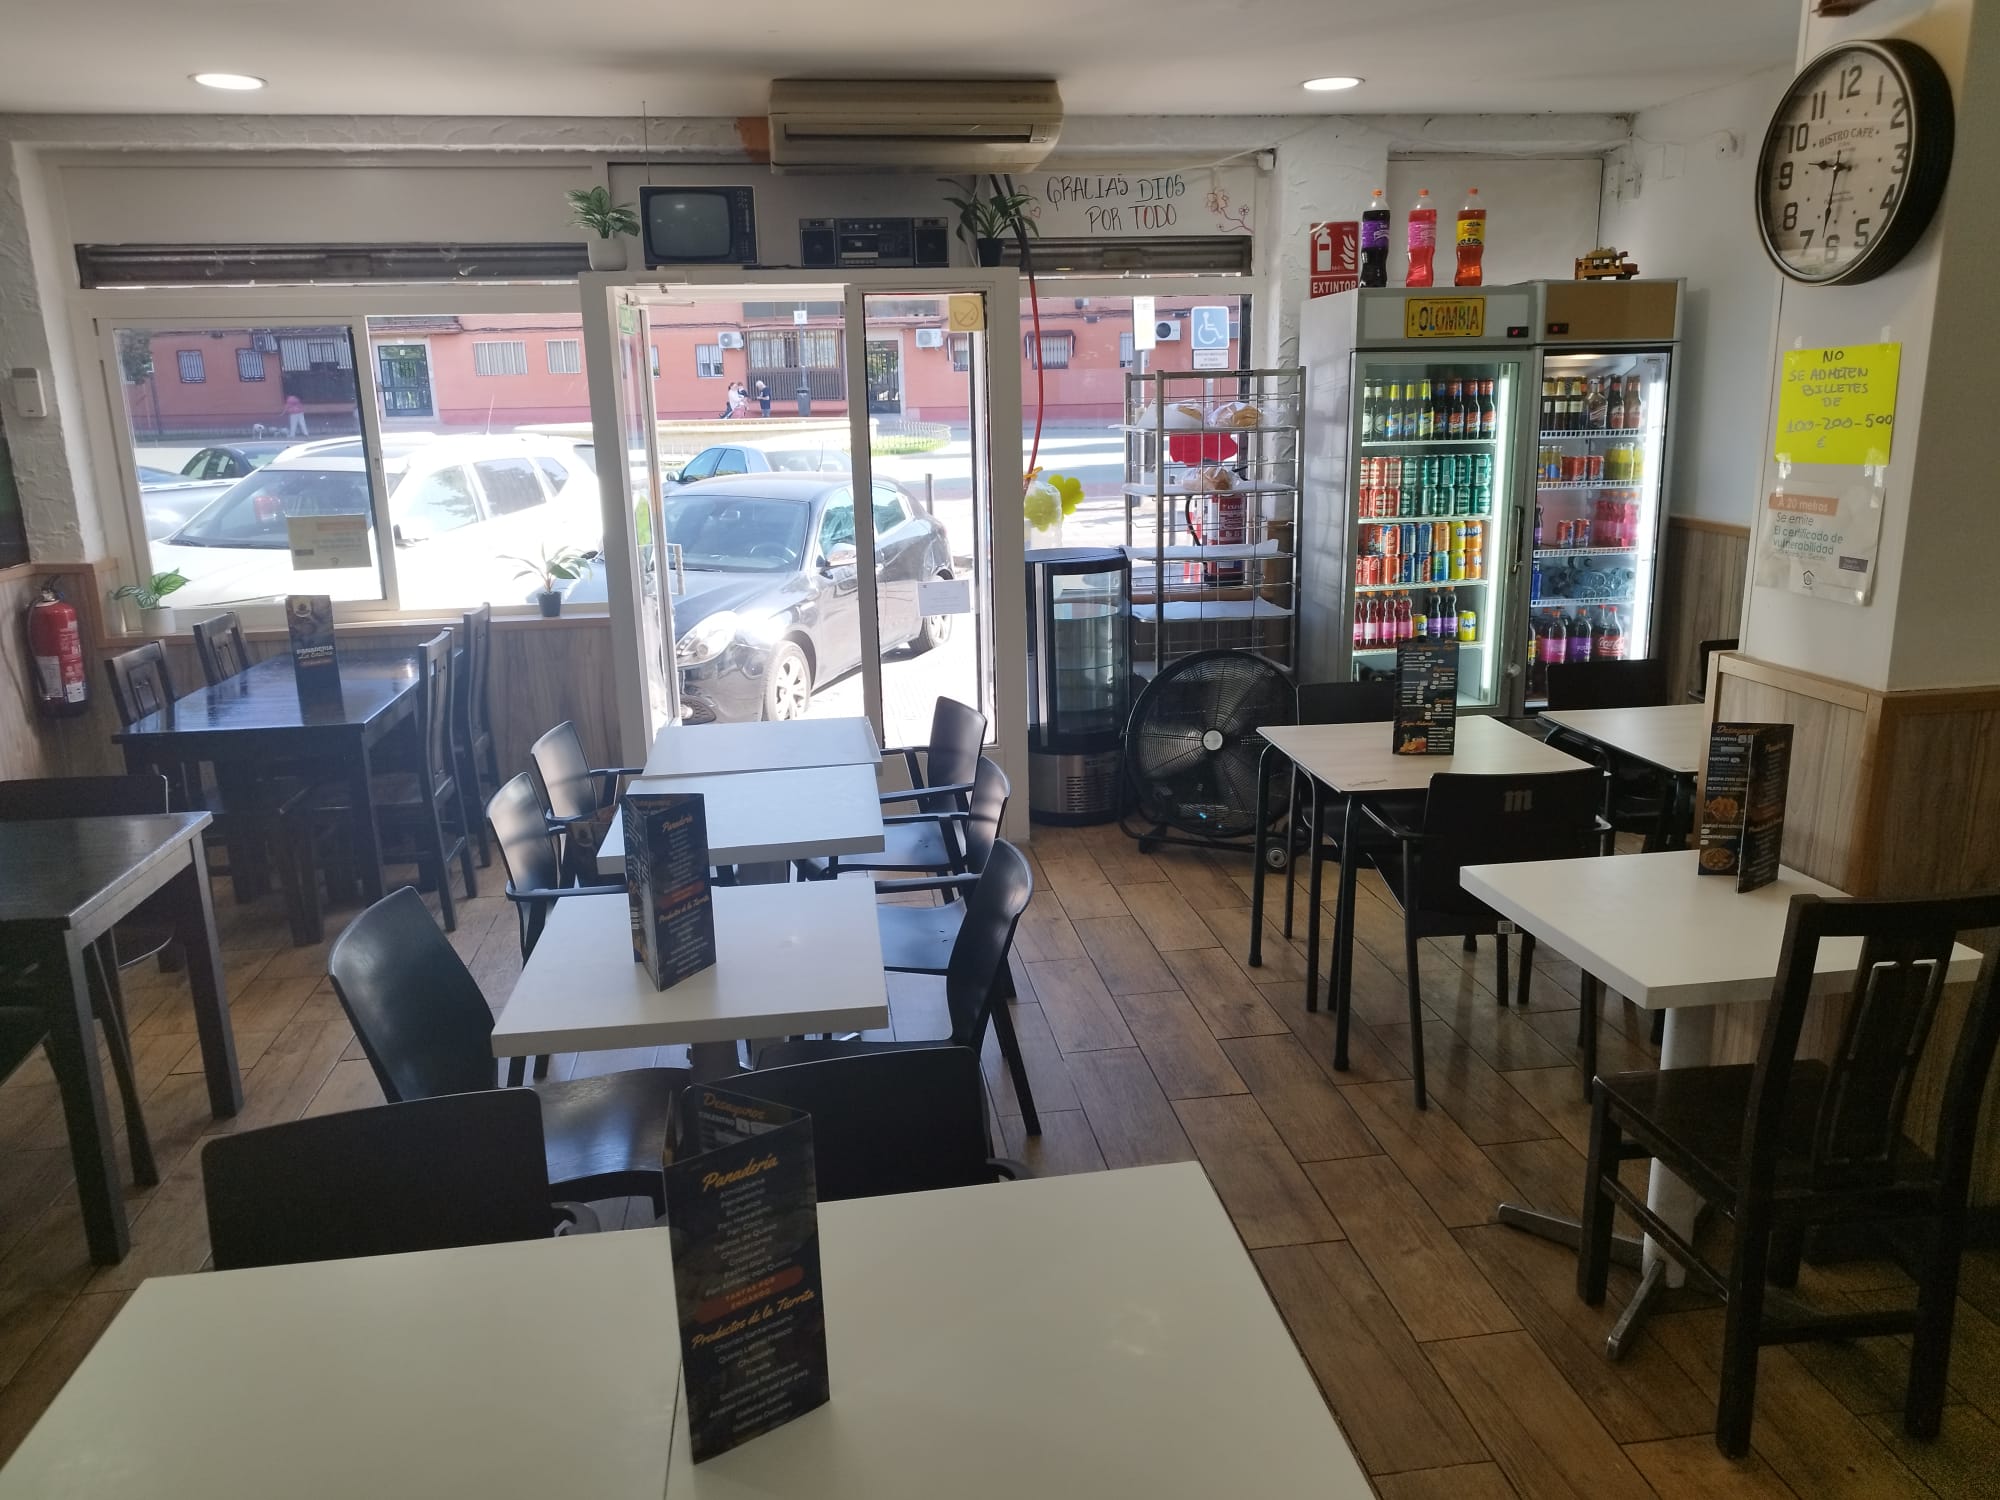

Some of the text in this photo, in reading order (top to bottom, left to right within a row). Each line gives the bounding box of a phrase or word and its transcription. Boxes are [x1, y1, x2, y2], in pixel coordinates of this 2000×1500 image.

[1838, 65, 1862, 100] 12
[1876, 75, 1884, 106] 1
[1811, 90, 1827, 121] 11
[1890, 97, 1908, 130] 2
[1787, 122, 1810, 154] 10
[1819, 129, 1849, 148] BISTRO
[1891, 143, 1908, 175] 3
[1136, 174, 1186, 202] DIOS
[1778, 161, 1794, 190] 9
[1879, 183, 1897, 210] 4
[1085, 203, 1177, 233] POR TODO
[1782, 202, 1799, 232] 8
[1799, 229, 1815, 256] 7
[1853, 218, 1870, 248] 5
[1824, 234, 1841, 264] 6
[1312, 280, 1357, 294] EXTINTOR
[1822, 350, 1845, 364] NO
[1788, 366, 1869, 382] SE ADMITEN
[1801, 383, 1869, 397] BILLETES
[1823, 397, 1842, 408] DE
[1776, 511, 1814, 526] Se emite
[1787, 497, 1798, 509] 20
[1799, 499, 1829, 512] metros
[1773, 537, 1834, 555] vulnerabilidad
[1782, 527, 1829, 542] certificado
[1830, 533, 1844, 544] de
[701, 1152, 778, 1192] Panadería
[691, 1317, 746, 1349] Productos
[747, 1310, 761, 1325] de
[762, 1304, 773, 1319] la
